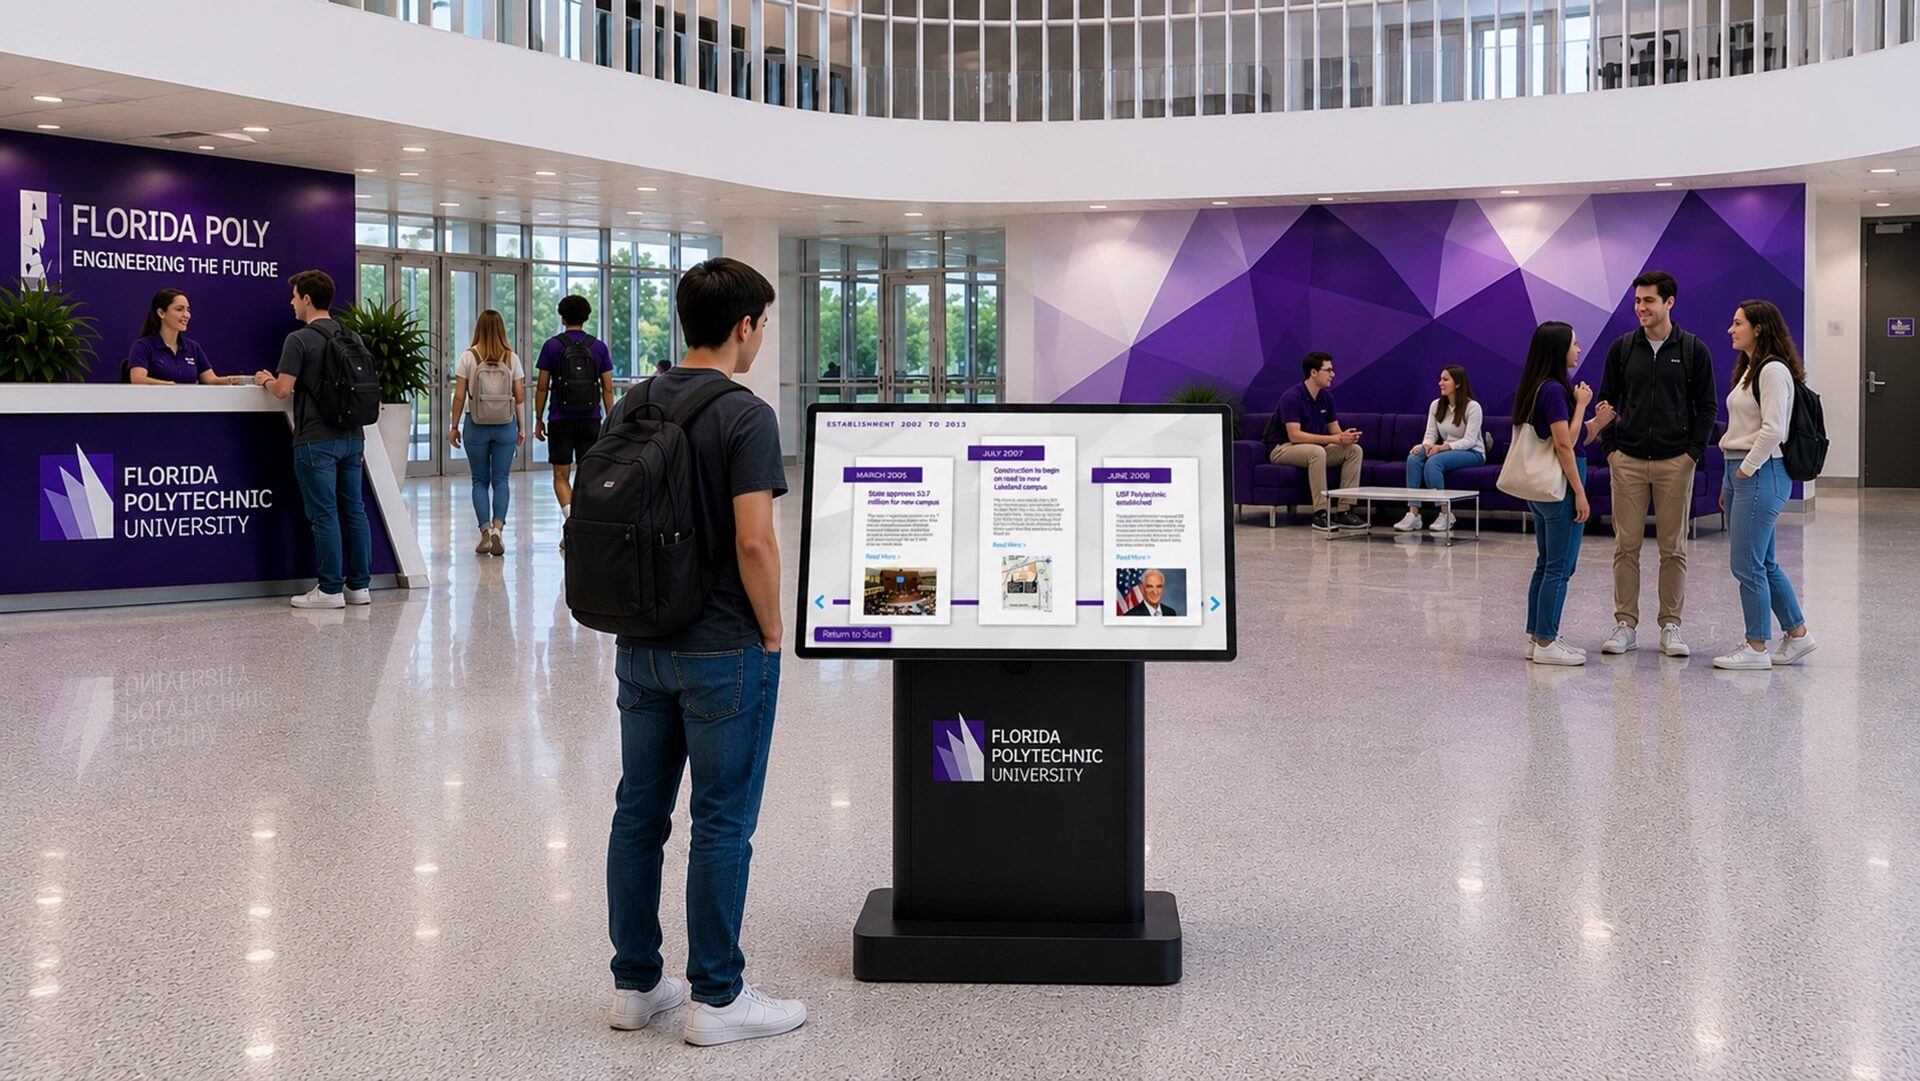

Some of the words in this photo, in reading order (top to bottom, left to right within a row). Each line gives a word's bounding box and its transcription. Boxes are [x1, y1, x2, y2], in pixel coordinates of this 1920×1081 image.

[72, 204, 198, 243] FLORIDA
[205, 216, 270, 248] POLY
[72, 250, 185, 273] ENGINEERING
[189, 258, 219, 275] THE
[222, 260, 278, 278] FUTURE
[124, 465, 218, 486] FLORIDA
[887, 471, 908, 479] 2005
[993, 466, 1033, 474] Construction
[1042, 467, 1060, 475] begin
[1107, 472, 1128, 480] JUNE
[868, 490, 885, 498] State
[993, 483, 1022, 491] Lakeland
[1023, 484, 1048, 492] campus
[1130, 491, 1167, 499] Polytechnic
[124, 490, 273, 512] POLYTECHNIC
[124, 516, 250, 538] UNIVERSITY
[822, 630, 850, 638] Return
[862, 629, 882, 638] Start
[991, 729, 1061, 744] FLORIDA
[991, 748, 1104, 764] POLYTECHNIC
[991, 767, 1084, 782] UNIVERSITY
